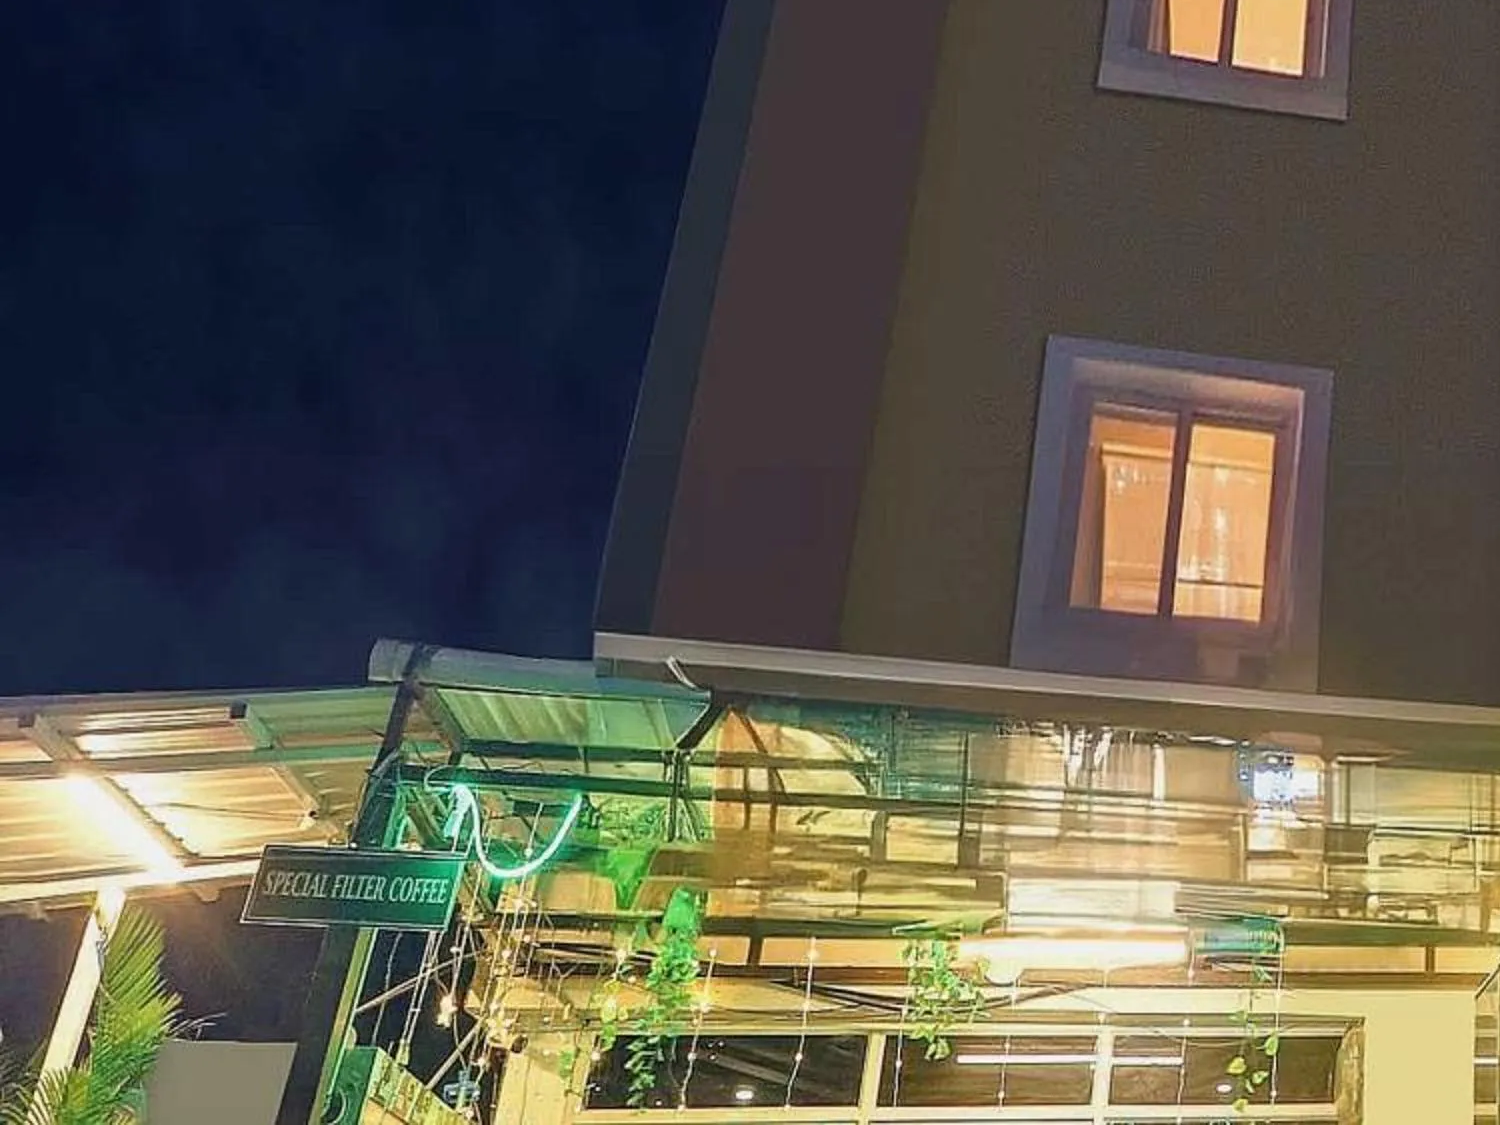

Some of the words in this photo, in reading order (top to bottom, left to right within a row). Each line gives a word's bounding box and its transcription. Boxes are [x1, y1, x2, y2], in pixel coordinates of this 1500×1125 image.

[263, 871, 327, 898] SPECIAL
[331, 875, 387, 901] FILTER
[388, 876, 449, 904] COFFEE
